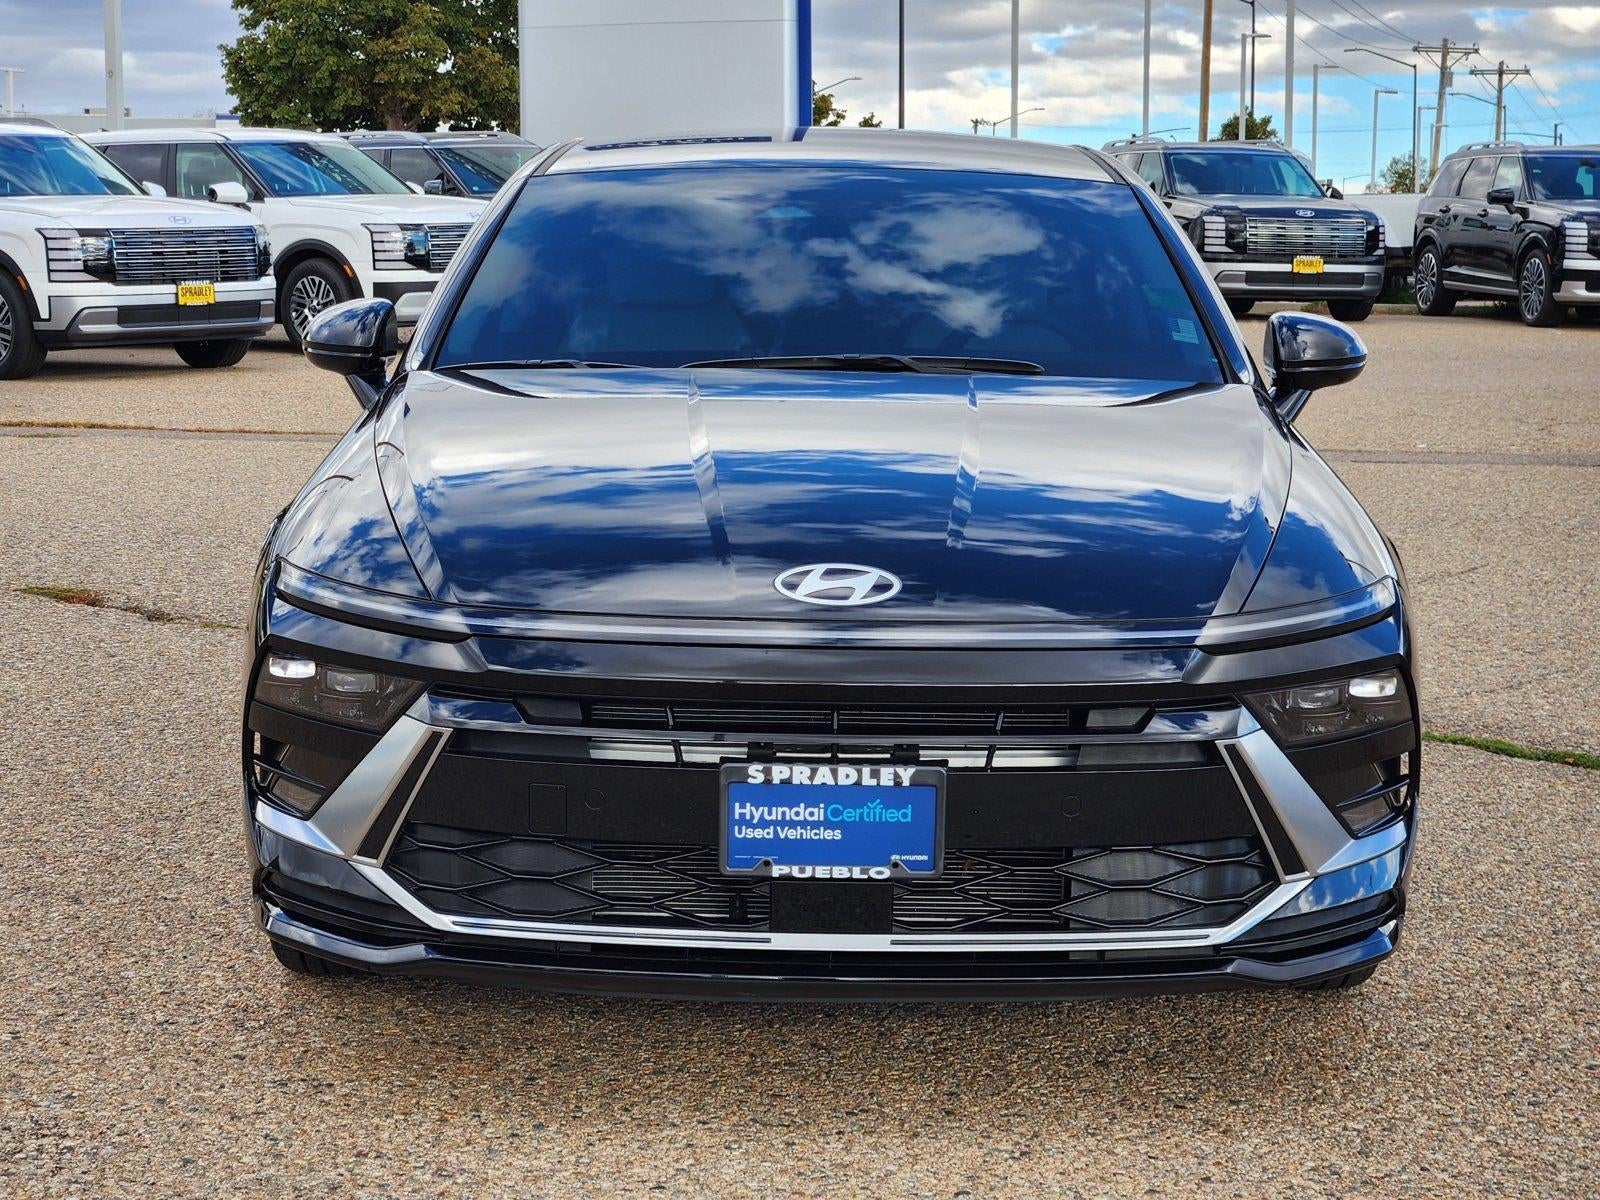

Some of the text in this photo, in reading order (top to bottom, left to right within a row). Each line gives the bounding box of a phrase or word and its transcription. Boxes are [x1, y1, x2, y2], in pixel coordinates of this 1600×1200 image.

[180, 286, 212, 297] SPRADLEY
[747, 765, 916, 787] SPRADLEY
[734, 798, 912, 824] Hyundai Certified
[734, 825, 842, 840] Used Vehicles
[771, 866, 891, 880] PUEBLO
